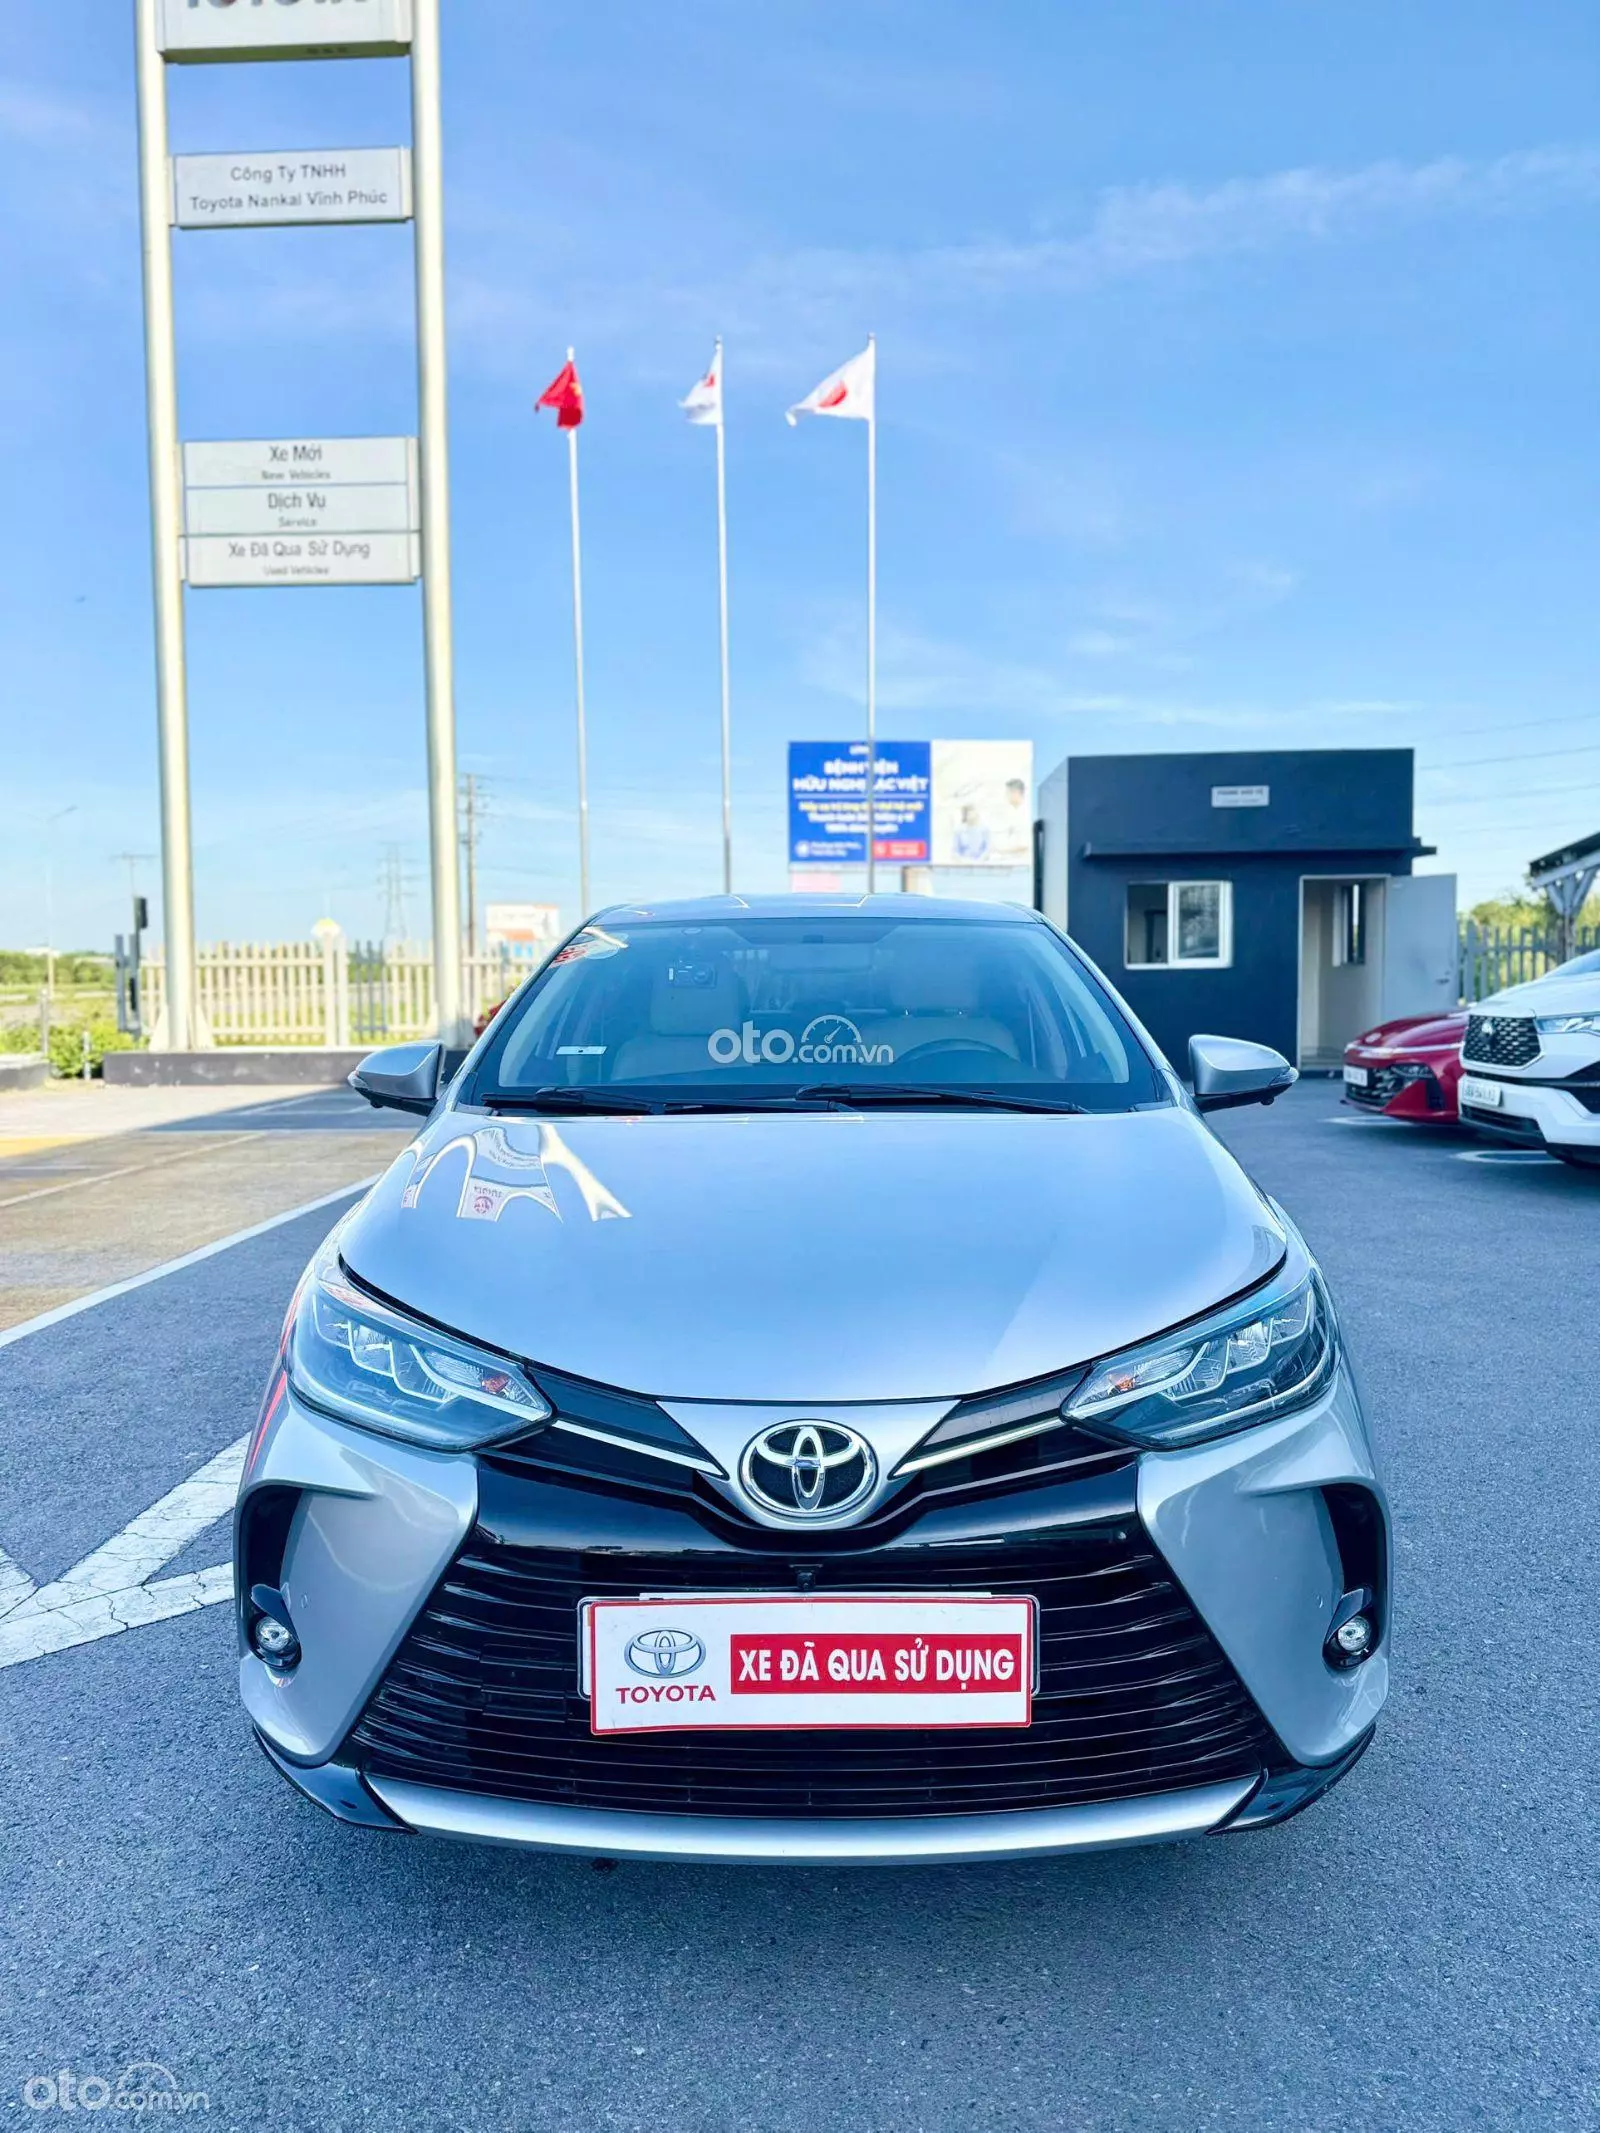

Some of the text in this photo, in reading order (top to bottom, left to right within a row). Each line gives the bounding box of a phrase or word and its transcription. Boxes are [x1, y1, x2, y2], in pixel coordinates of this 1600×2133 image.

[230, 163, 346, 182] Công Ty TNHH
[190, 195, 243, 213] Toyota
[306, 190, 343, 206] Vĩnh
[348, 188, 388, 205] Phúc
[269, 443, 323, 462] Xe Mới
[289, 469, 331, 480] Vehicles
[268, 492, 327, 511] Dịch Vụ
[228, 542, 246, 558] Xe
[273, 541, 302, 557] Qua
[333, 540, 371, 559] Dụng
[738, 1638, 1015, 1690] XE ĐÃ QUA SỬ DỤNG
[616, 1684, 716, 1704] TOYOTA
